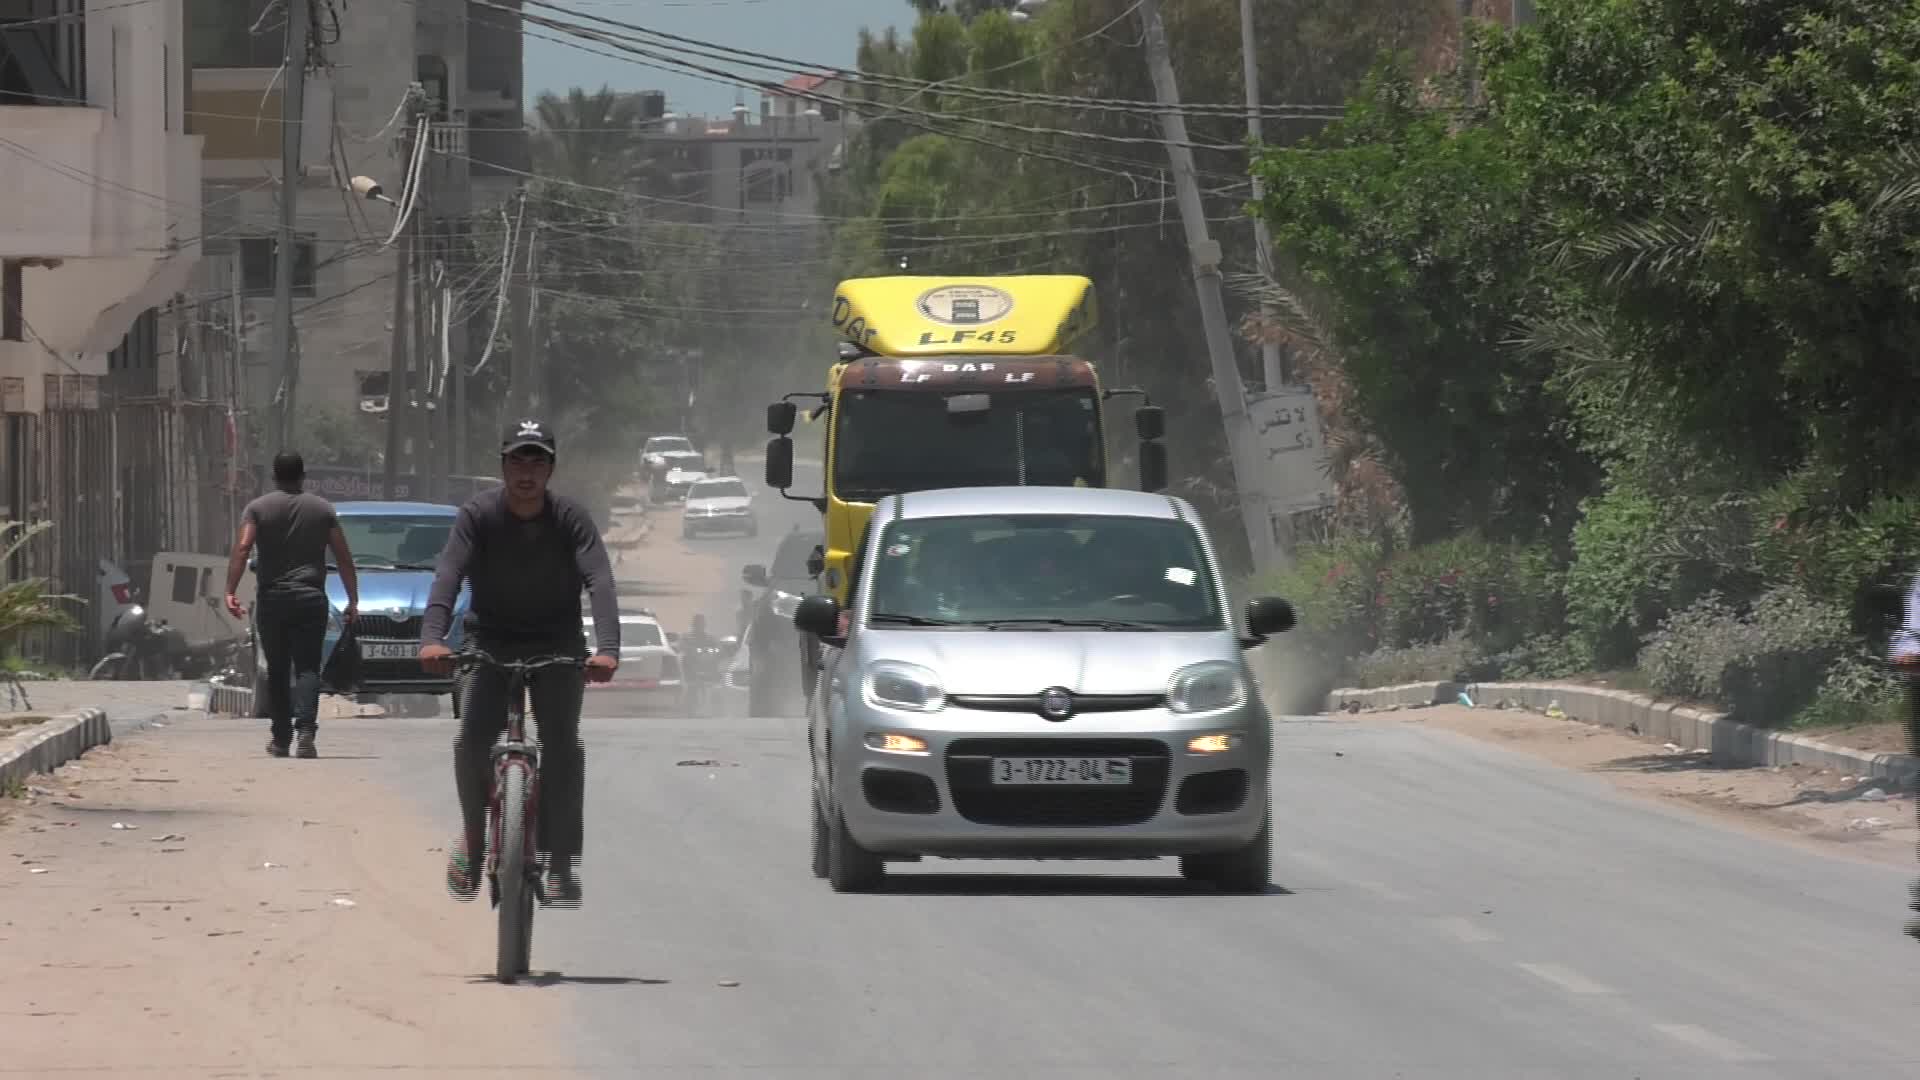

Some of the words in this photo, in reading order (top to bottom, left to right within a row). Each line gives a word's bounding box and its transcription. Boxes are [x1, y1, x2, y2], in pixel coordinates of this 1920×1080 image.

[919, 330, 1017, 346] LF45
[942, 362, 997, 372] DAF
[900, 373, 933, 383] LF
[1004, 372, 1036, 383] LF
[367, 645, 420, 658] 3-4501-0
[999, 759, 1103, 781] 3-1722-04
